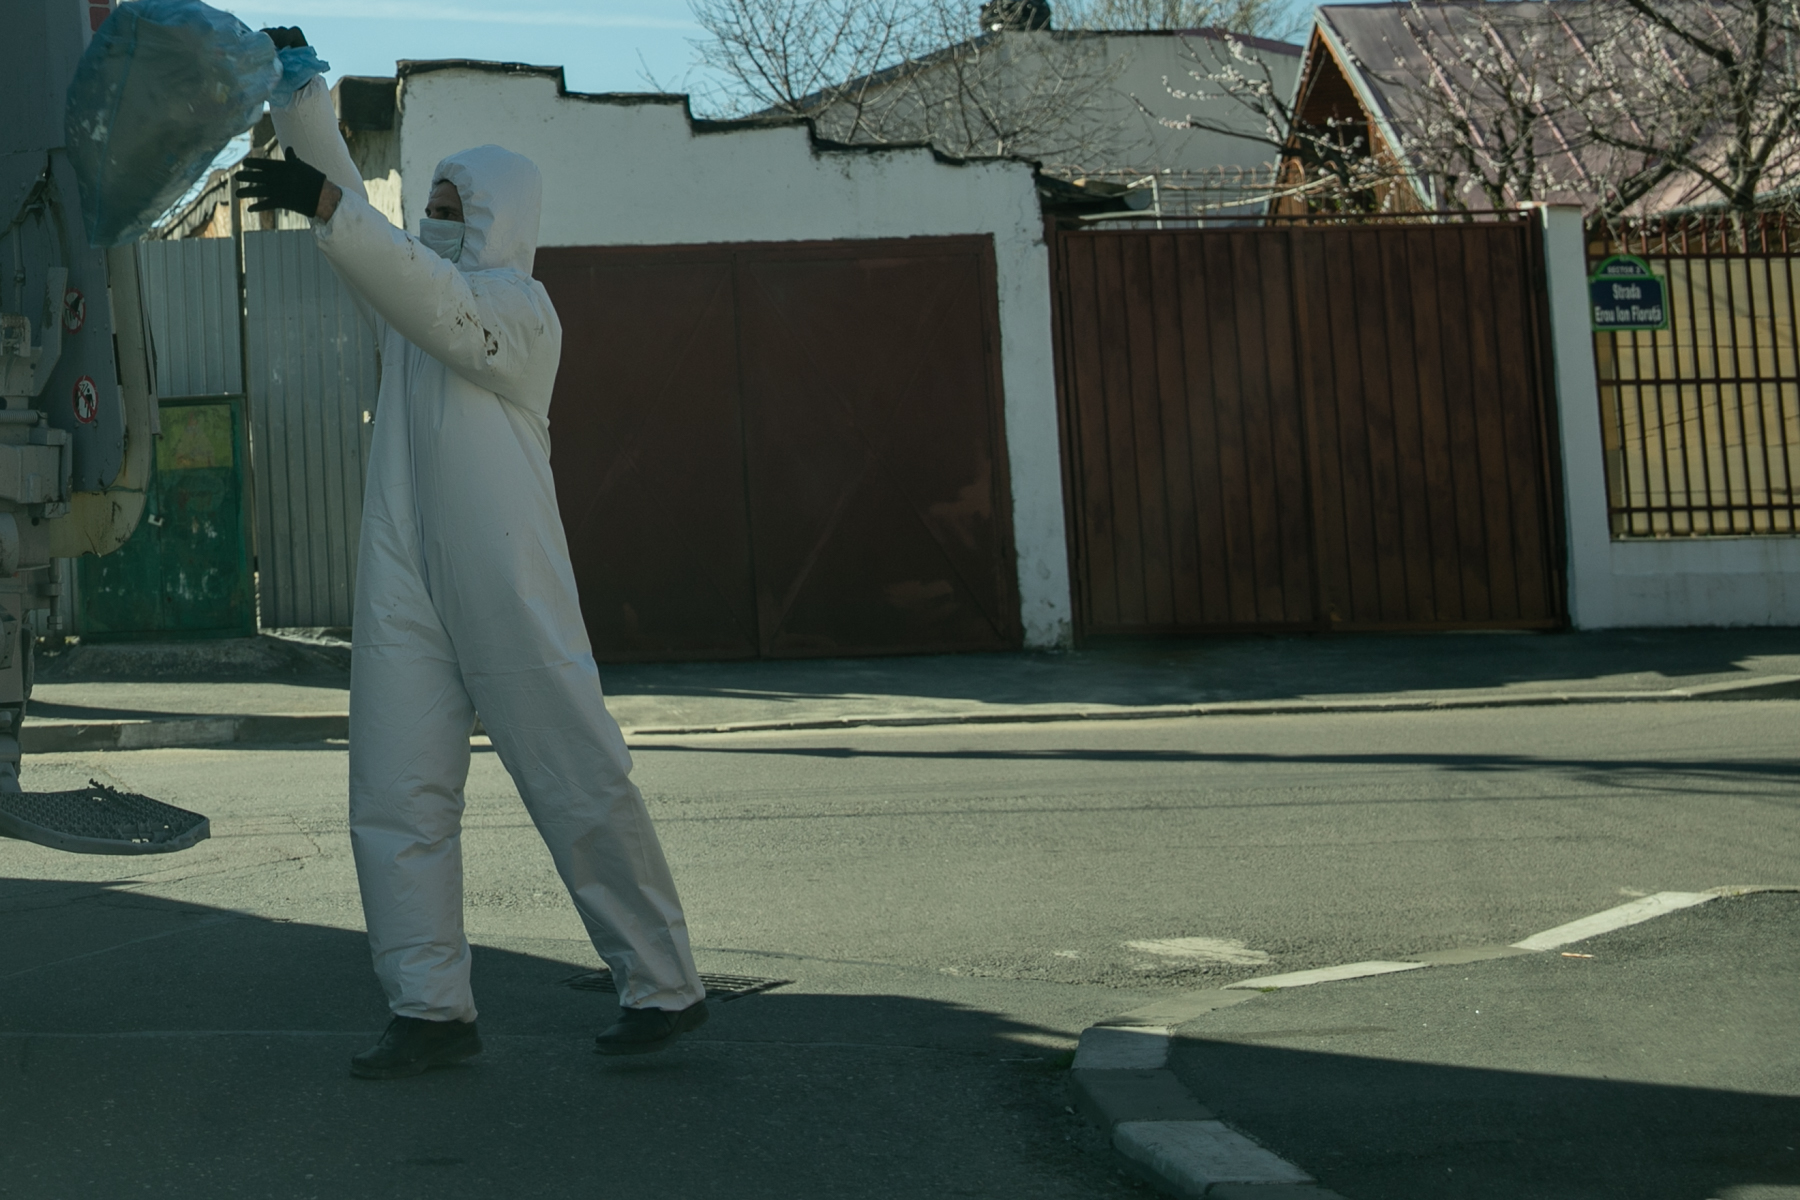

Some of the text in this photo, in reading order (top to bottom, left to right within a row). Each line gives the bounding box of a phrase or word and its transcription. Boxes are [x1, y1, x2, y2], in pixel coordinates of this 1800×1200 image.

[1607, 265, 1634, 274] SECTOR
[1612, 283, 1641, 300] Strada
[1595, 306, 1615, 322] Erou
[1616, 306, 1630, 322] Ion
